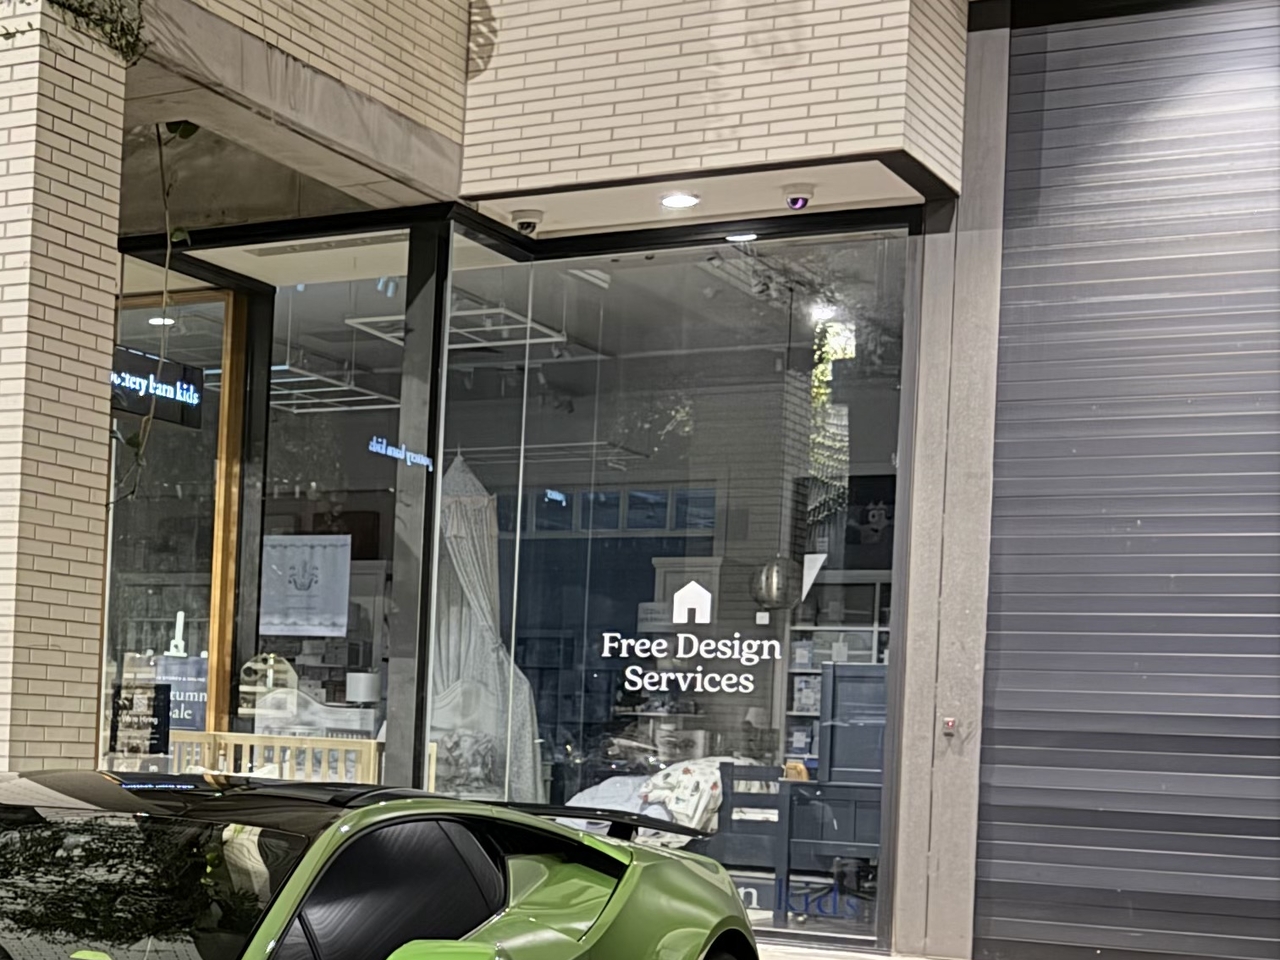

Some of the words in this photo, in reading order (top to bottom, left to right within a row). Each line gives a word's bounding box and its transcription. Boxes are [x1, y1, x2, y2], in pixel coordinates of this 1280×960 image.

[176, 381, 200, 405] kids
[601, 632, 668, 658] Free
[676, 632, 782, 666] Design
[624, 665, 755, 693] Services
[170, 691, 208, 702] tumn
